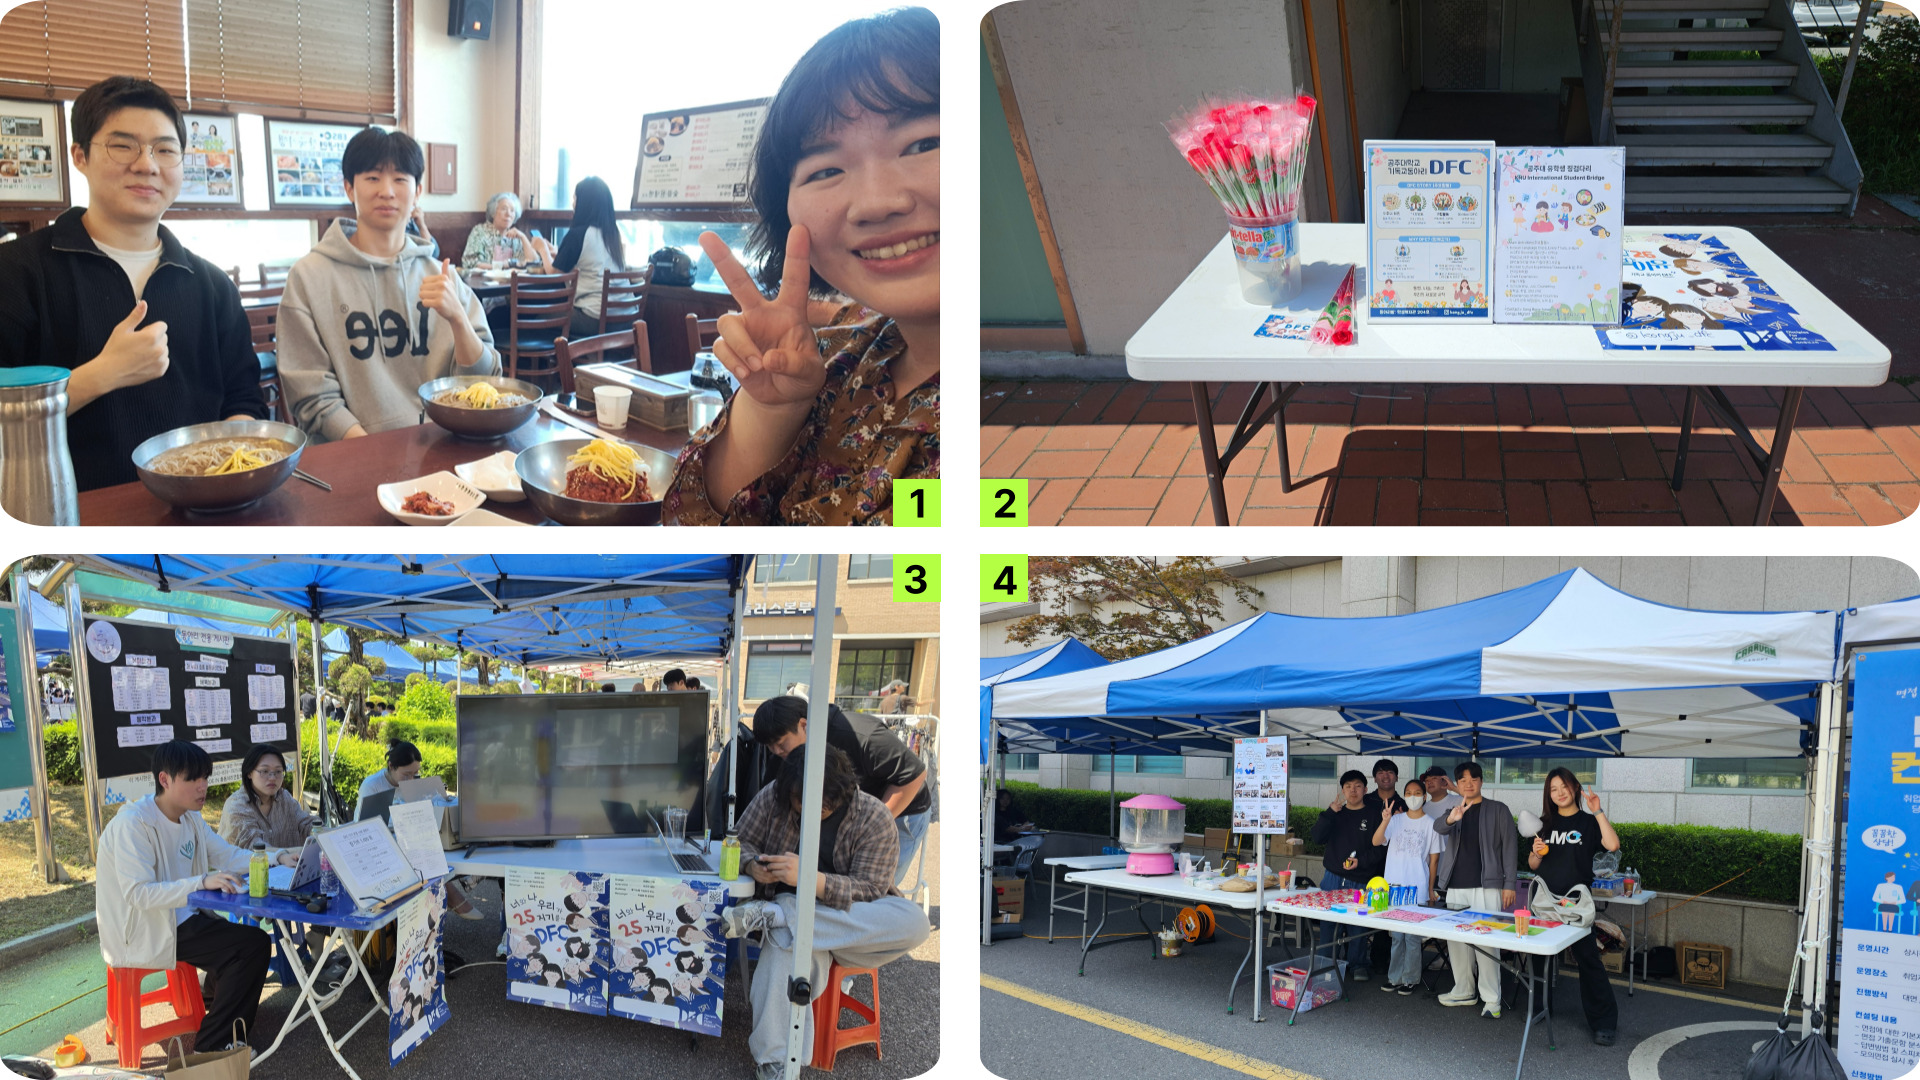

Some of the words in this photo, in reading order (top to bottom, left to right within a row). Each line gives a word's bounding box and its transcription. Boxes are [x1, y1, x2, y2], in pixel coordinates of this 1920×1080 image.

[1429, 160, 1471, 175] DFC
[1735, 642, 1776, 660] CARAVAN
[1896, 687, 1918, 698] 면접
[1872, 828, 1896, 838] 꼼꼼한
[511, 898, 526, 909] 너와
[527, 892, 537, 902] 나
[537, 900, 563, 913] 우리가
[513, 909, 535, 926] 25
[616, 908, 633, 919] 너와
[635, 902, 646, 912] 나
[646, 910, 675, 926] 우리가
[534, 924, 570, 944] DFC
[618, 920, 642, 937] 25
[641, 937, 680, 958] DFC
[1857, 944, 1889, 954] 운영시간
[1856, 967, 1888, 977] 운영장소
[1856, 988, 1888, 999] 진행방식
[1903, 994, 1917, 1002] 대면
[1855, 1011, 1879, 1022] 컨설팅
[1881, 1015, 1897, 1024] 내용
[1861, 1025, 1882, 1034] 면접에
[1885, 1027, 1899, 1037] 대한
[1861, 1033, 1875, 1042] 면접
[1878, 1035, 1906, 1047] 기출문항
[1860, 1041, 1890, 1053] 답변방법
[1891, 1046, 1898, 1054] 및
[1860, 1050, 1889, 1062] 모의면접
[1890, 1055, 1906, 1065] 실시
[1907, 1057, 1915, 1066] 후
[1851, 1070, 1882, 1080] 신청방법
